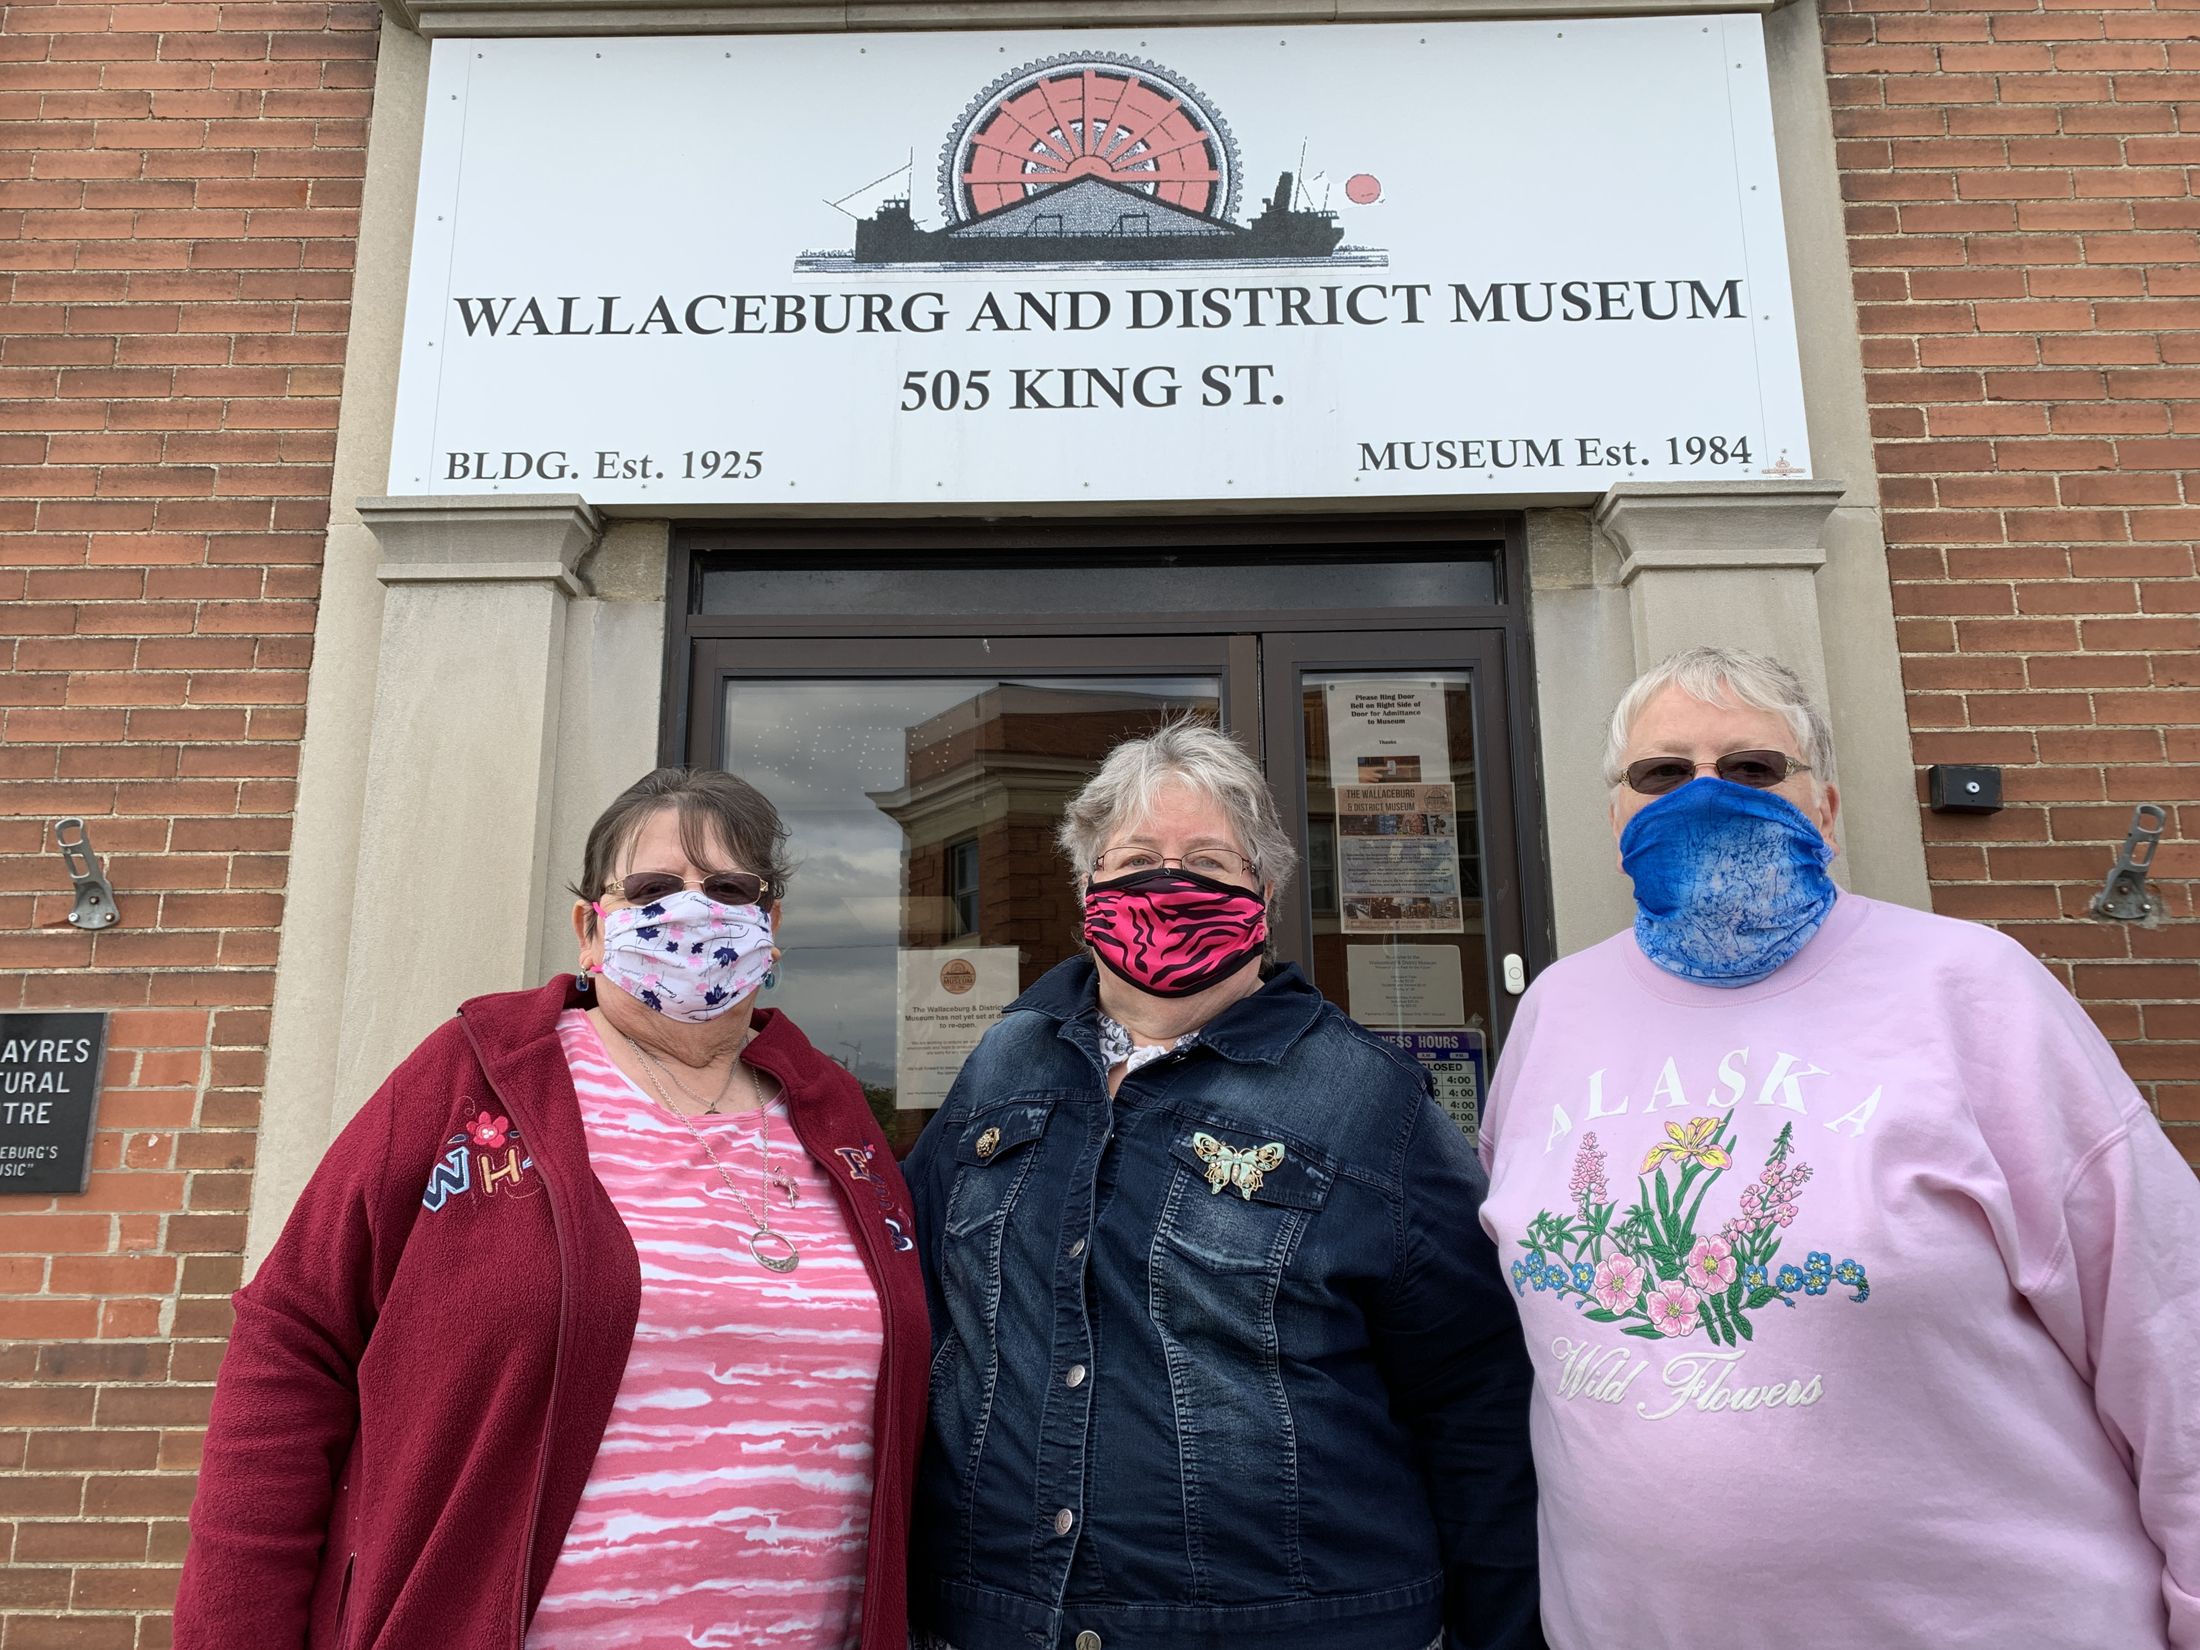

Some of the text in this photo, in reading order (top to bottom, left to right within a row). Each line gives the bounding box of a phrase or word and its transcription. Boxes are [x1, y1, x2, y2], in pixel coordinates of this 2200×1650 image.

[453, 279, 1746, 337] WALLACEBURG AND DISTRICT MUSEUM
[901, 364, 1284, 412] 505 KING ST.
[445, 450, 763, 481] BLDG. Est. 1925
[1359, 436, 1752, 471] MUSEUM Est. 1984
[1347, 789, 1416, 799] THE WALLACEBURG
[1354, 803, 1384, 812] DISTRICT
[1385, 802, 1415, 811] MUSEUM
[0, 1038, 91, 1063] AYRES
[1418, 1035, 1459, 1049] HOURS
[0, 1071, 70, 1094] URAL
[1447, 1076, 1471, 1084] 4:00
[3, 1101, 53, 1125] TRE
[1542, 1046, 1883, 1155] ALASKA
[1551, 1336, 1824, 1421] Wild Flowers
